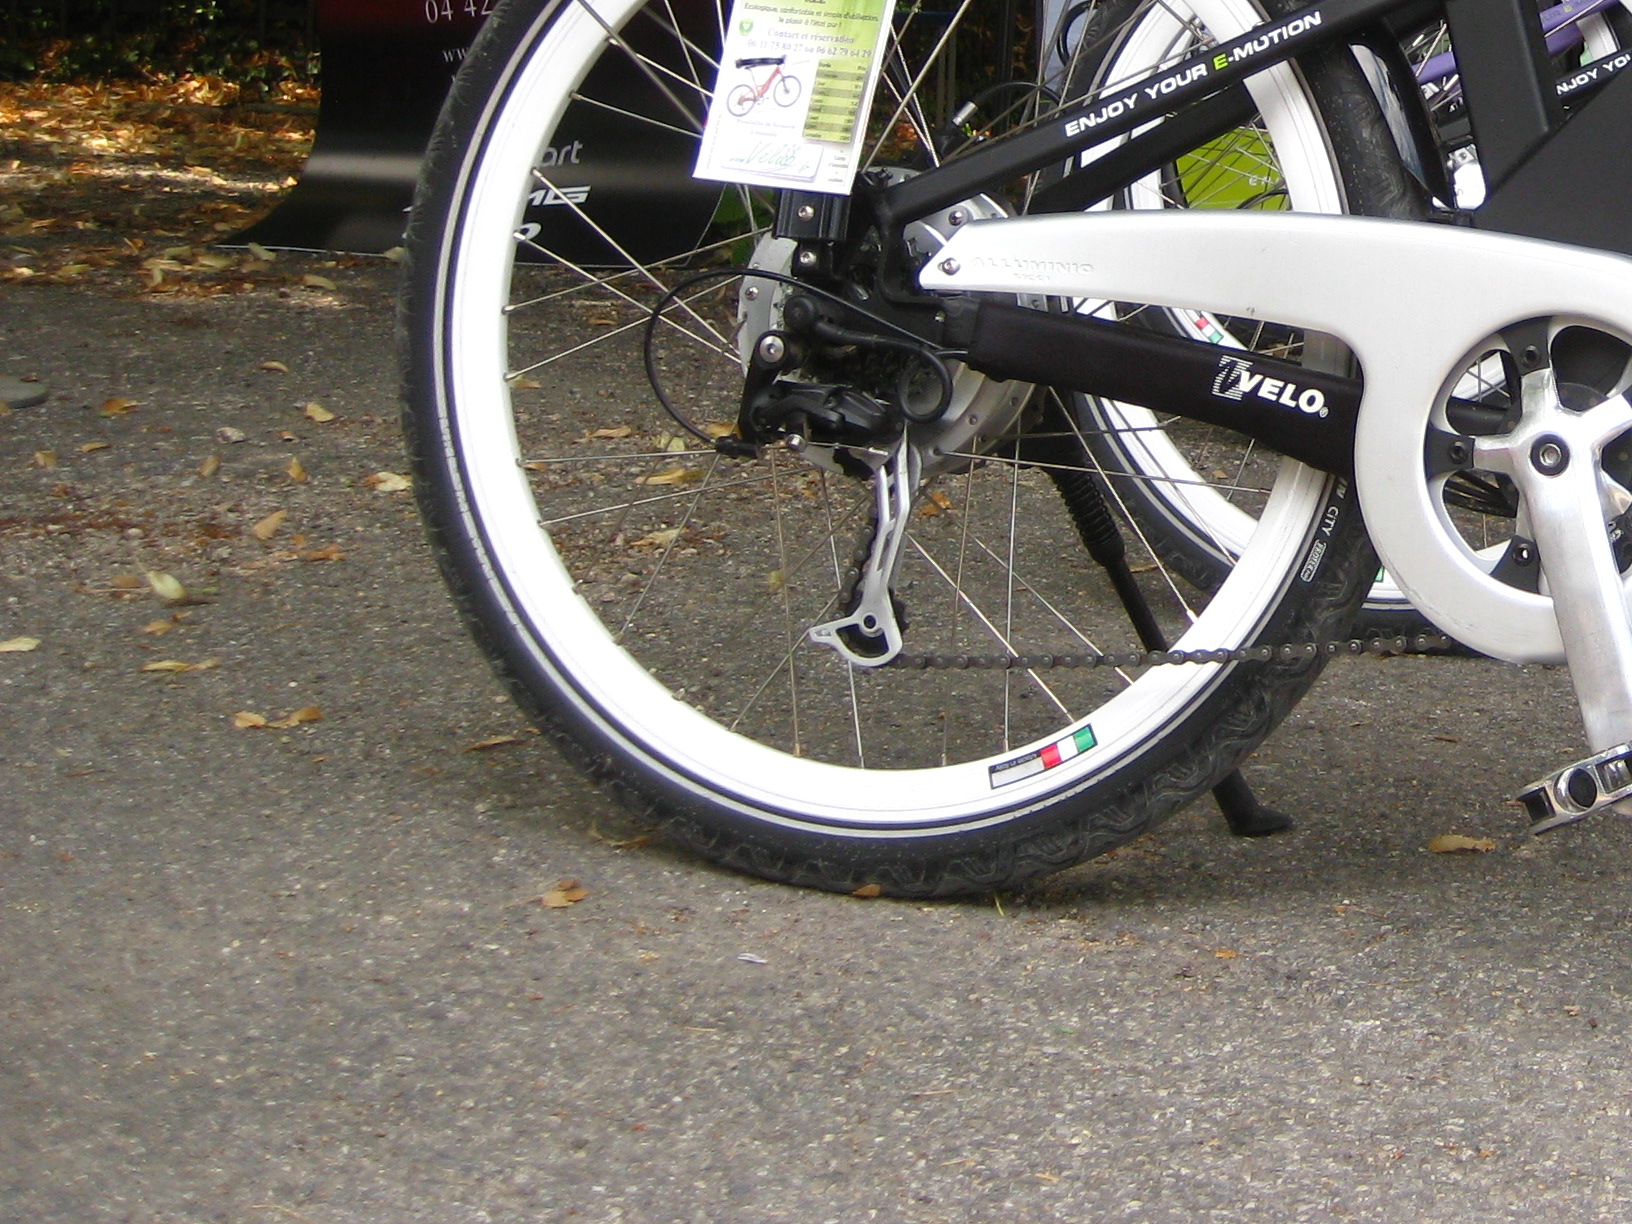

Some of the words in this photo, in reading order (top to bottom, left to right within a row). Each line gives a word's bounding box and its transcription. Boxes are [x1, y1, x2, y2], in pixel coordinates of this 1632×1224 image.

[1064, 92, 1138, 138] ENJOY
[1144, 63, 1208, 100] YOUR
[1212, 10, 1322, 71] E-MOTION
